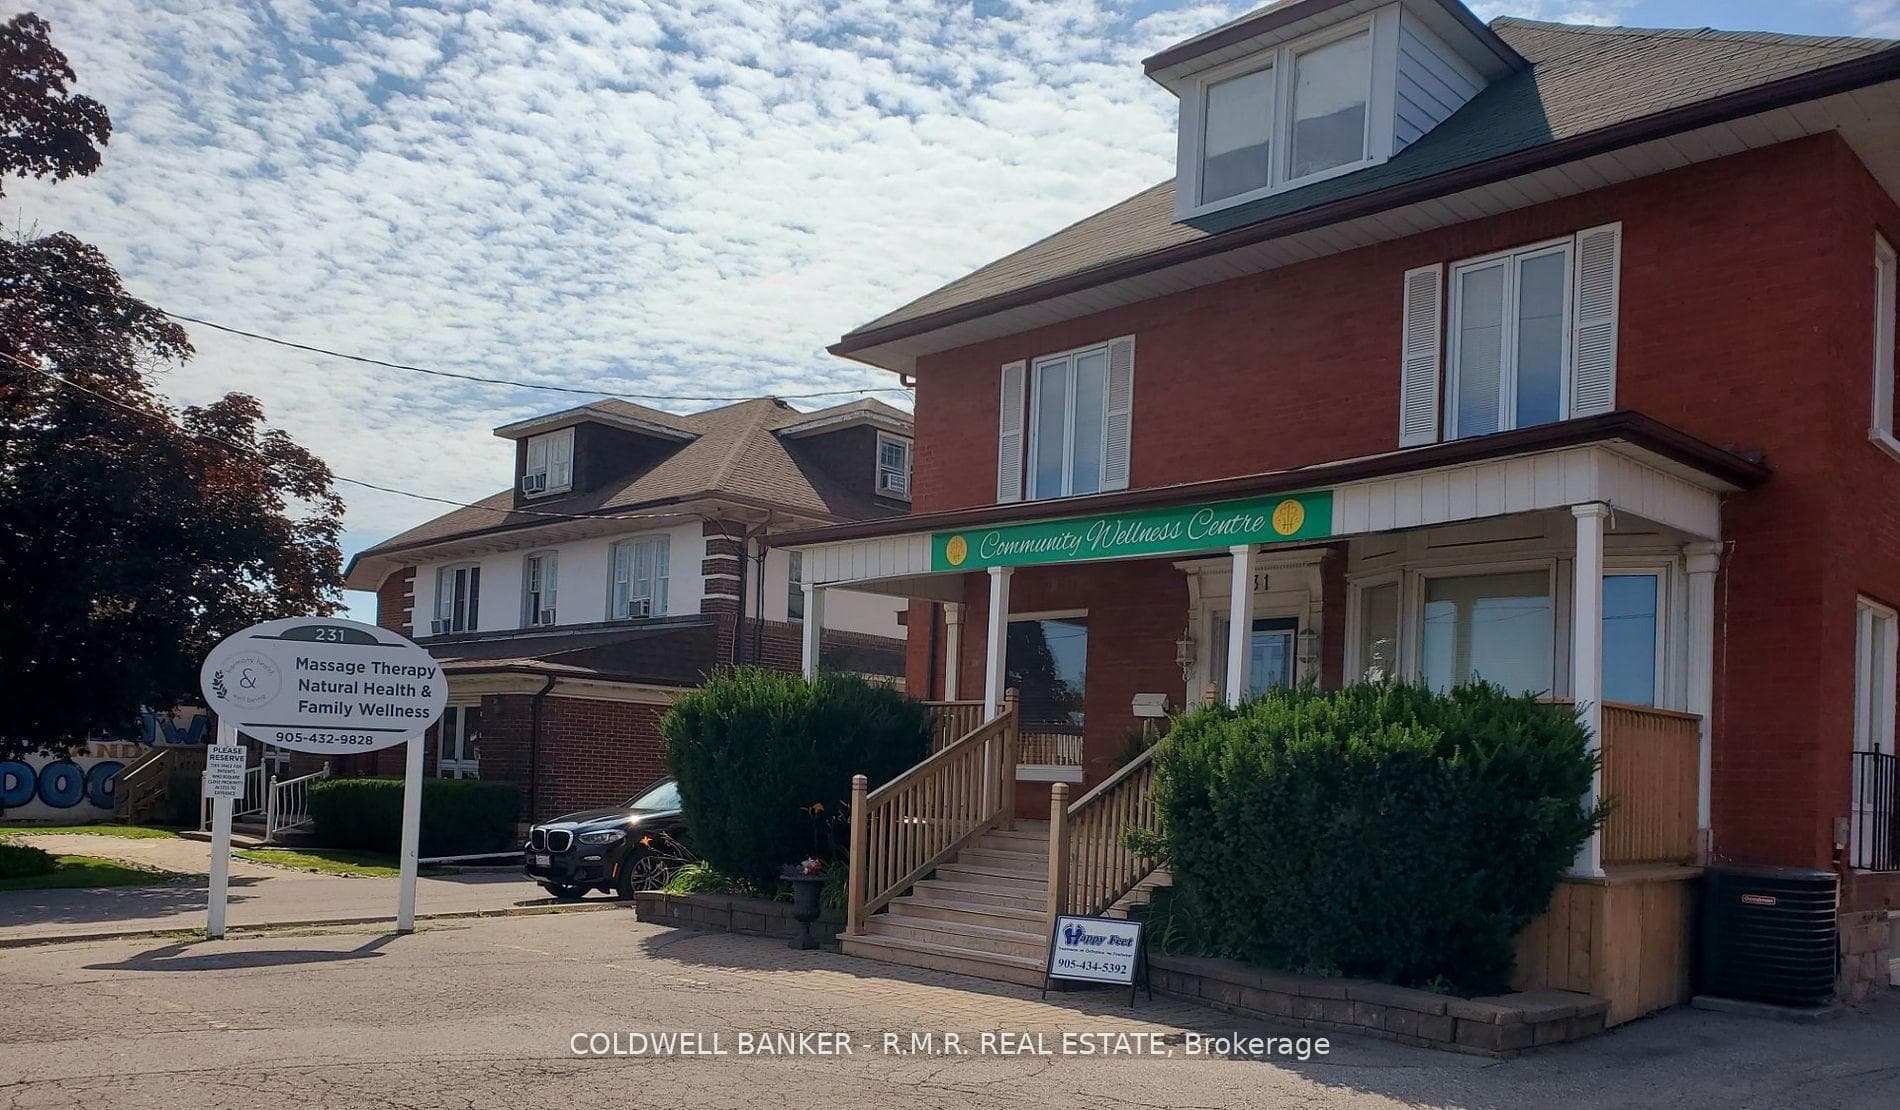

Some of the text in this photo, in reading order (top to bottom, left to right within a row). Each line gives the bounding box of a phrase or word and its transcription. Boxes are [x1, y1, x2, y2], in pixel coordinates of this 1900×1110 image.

[980, 507, 1265, 560] Community Wellness Centre
[315, 628, 345, 641] 231
[296, 656, 366, 674] Massage
[371, 661, 437, 679] Therapy
[299, 679, 432, 698] Natural Health &
[299, 700, 430, 719] Family Wellness
[276, 732, 374, 746] 905-432-9828
[1063, 922, 1134, 948] Happy Feet
[1059, 958, 1127, 974] 905-434-5392
